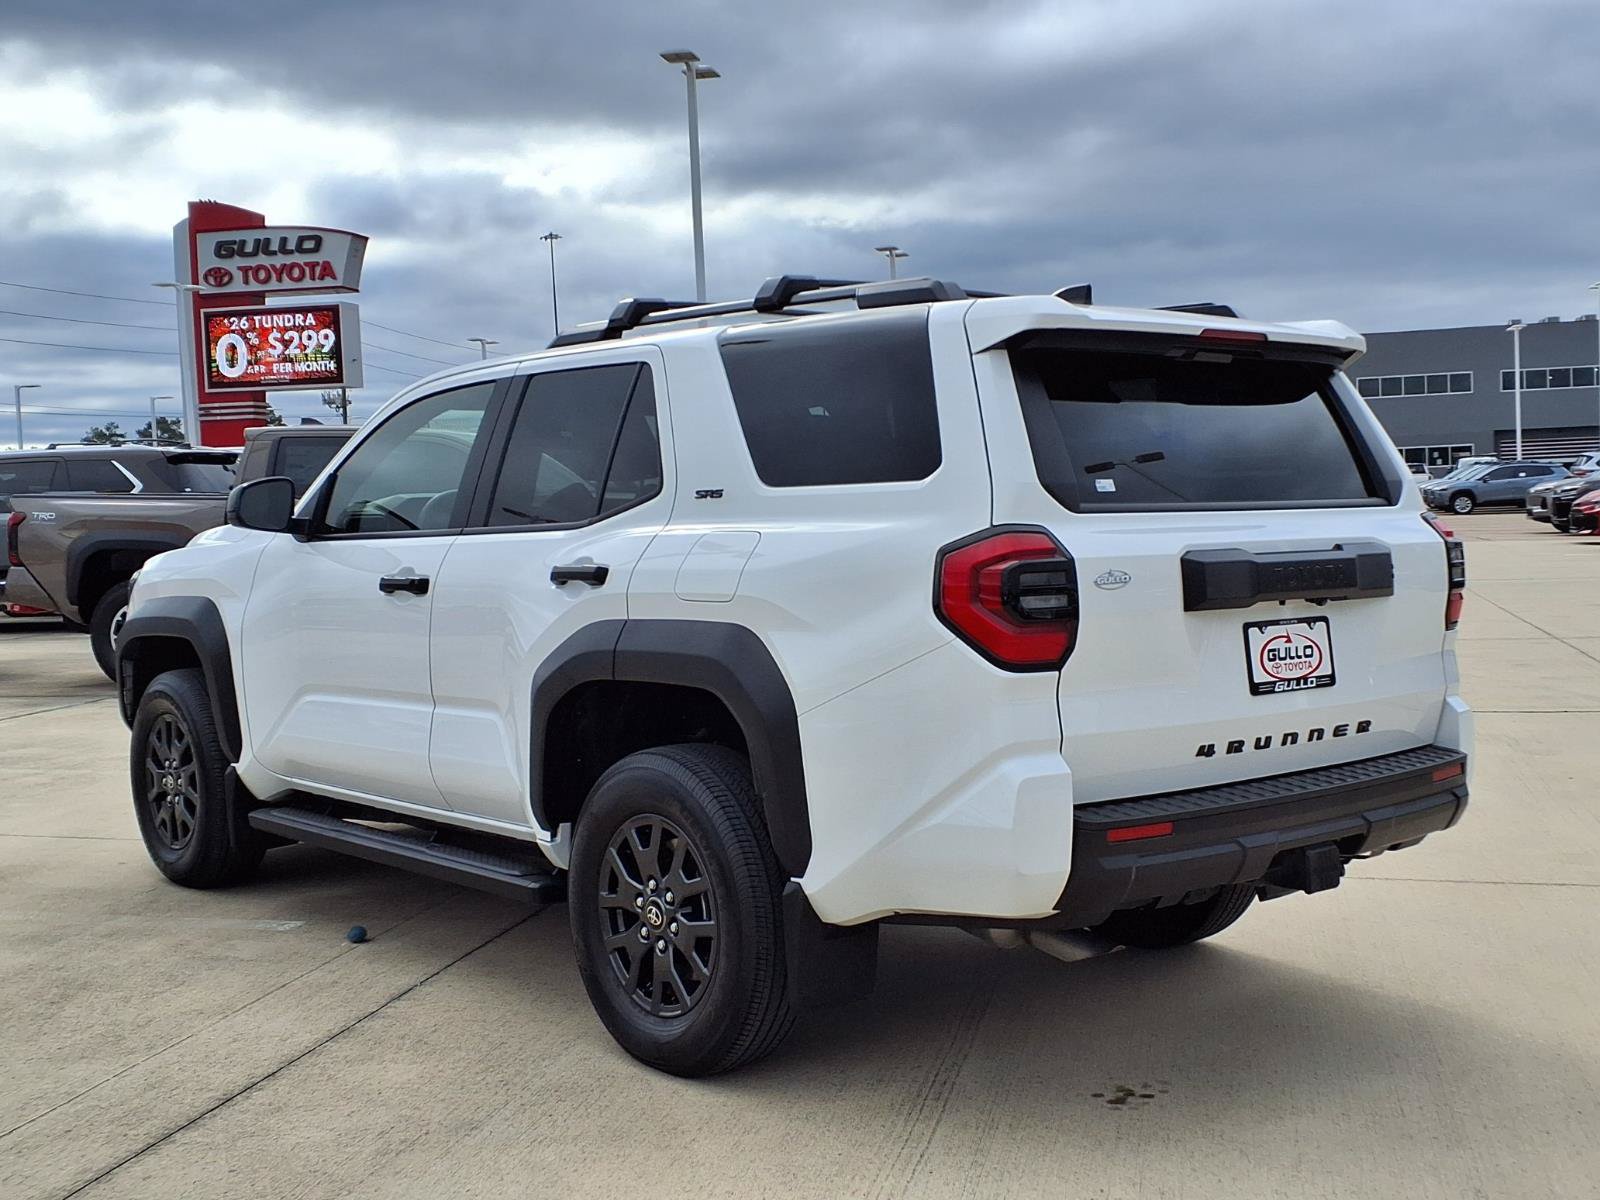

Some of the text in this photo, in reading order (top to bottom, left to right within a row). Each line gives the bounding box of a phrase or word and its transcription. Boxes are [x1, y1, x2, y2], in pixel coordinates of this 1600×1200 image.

[213, 235, 322, 259] GULLO
[237, 261, 338, 285] TOYOTA
[254, 313, 316, 328] TUNDRA
[268, 328, 336, 358] $299
[273, 362, 293, 374] PER
[294, 360, 335, 373] MONTH
[1267, 644, 1314, 662] GULLO
[1283, 661, 1314, 673] TOYOTA
[1274, 678, 1317, 692] GULLO
[1195, 719, 1372, 758] 4RUNNER
